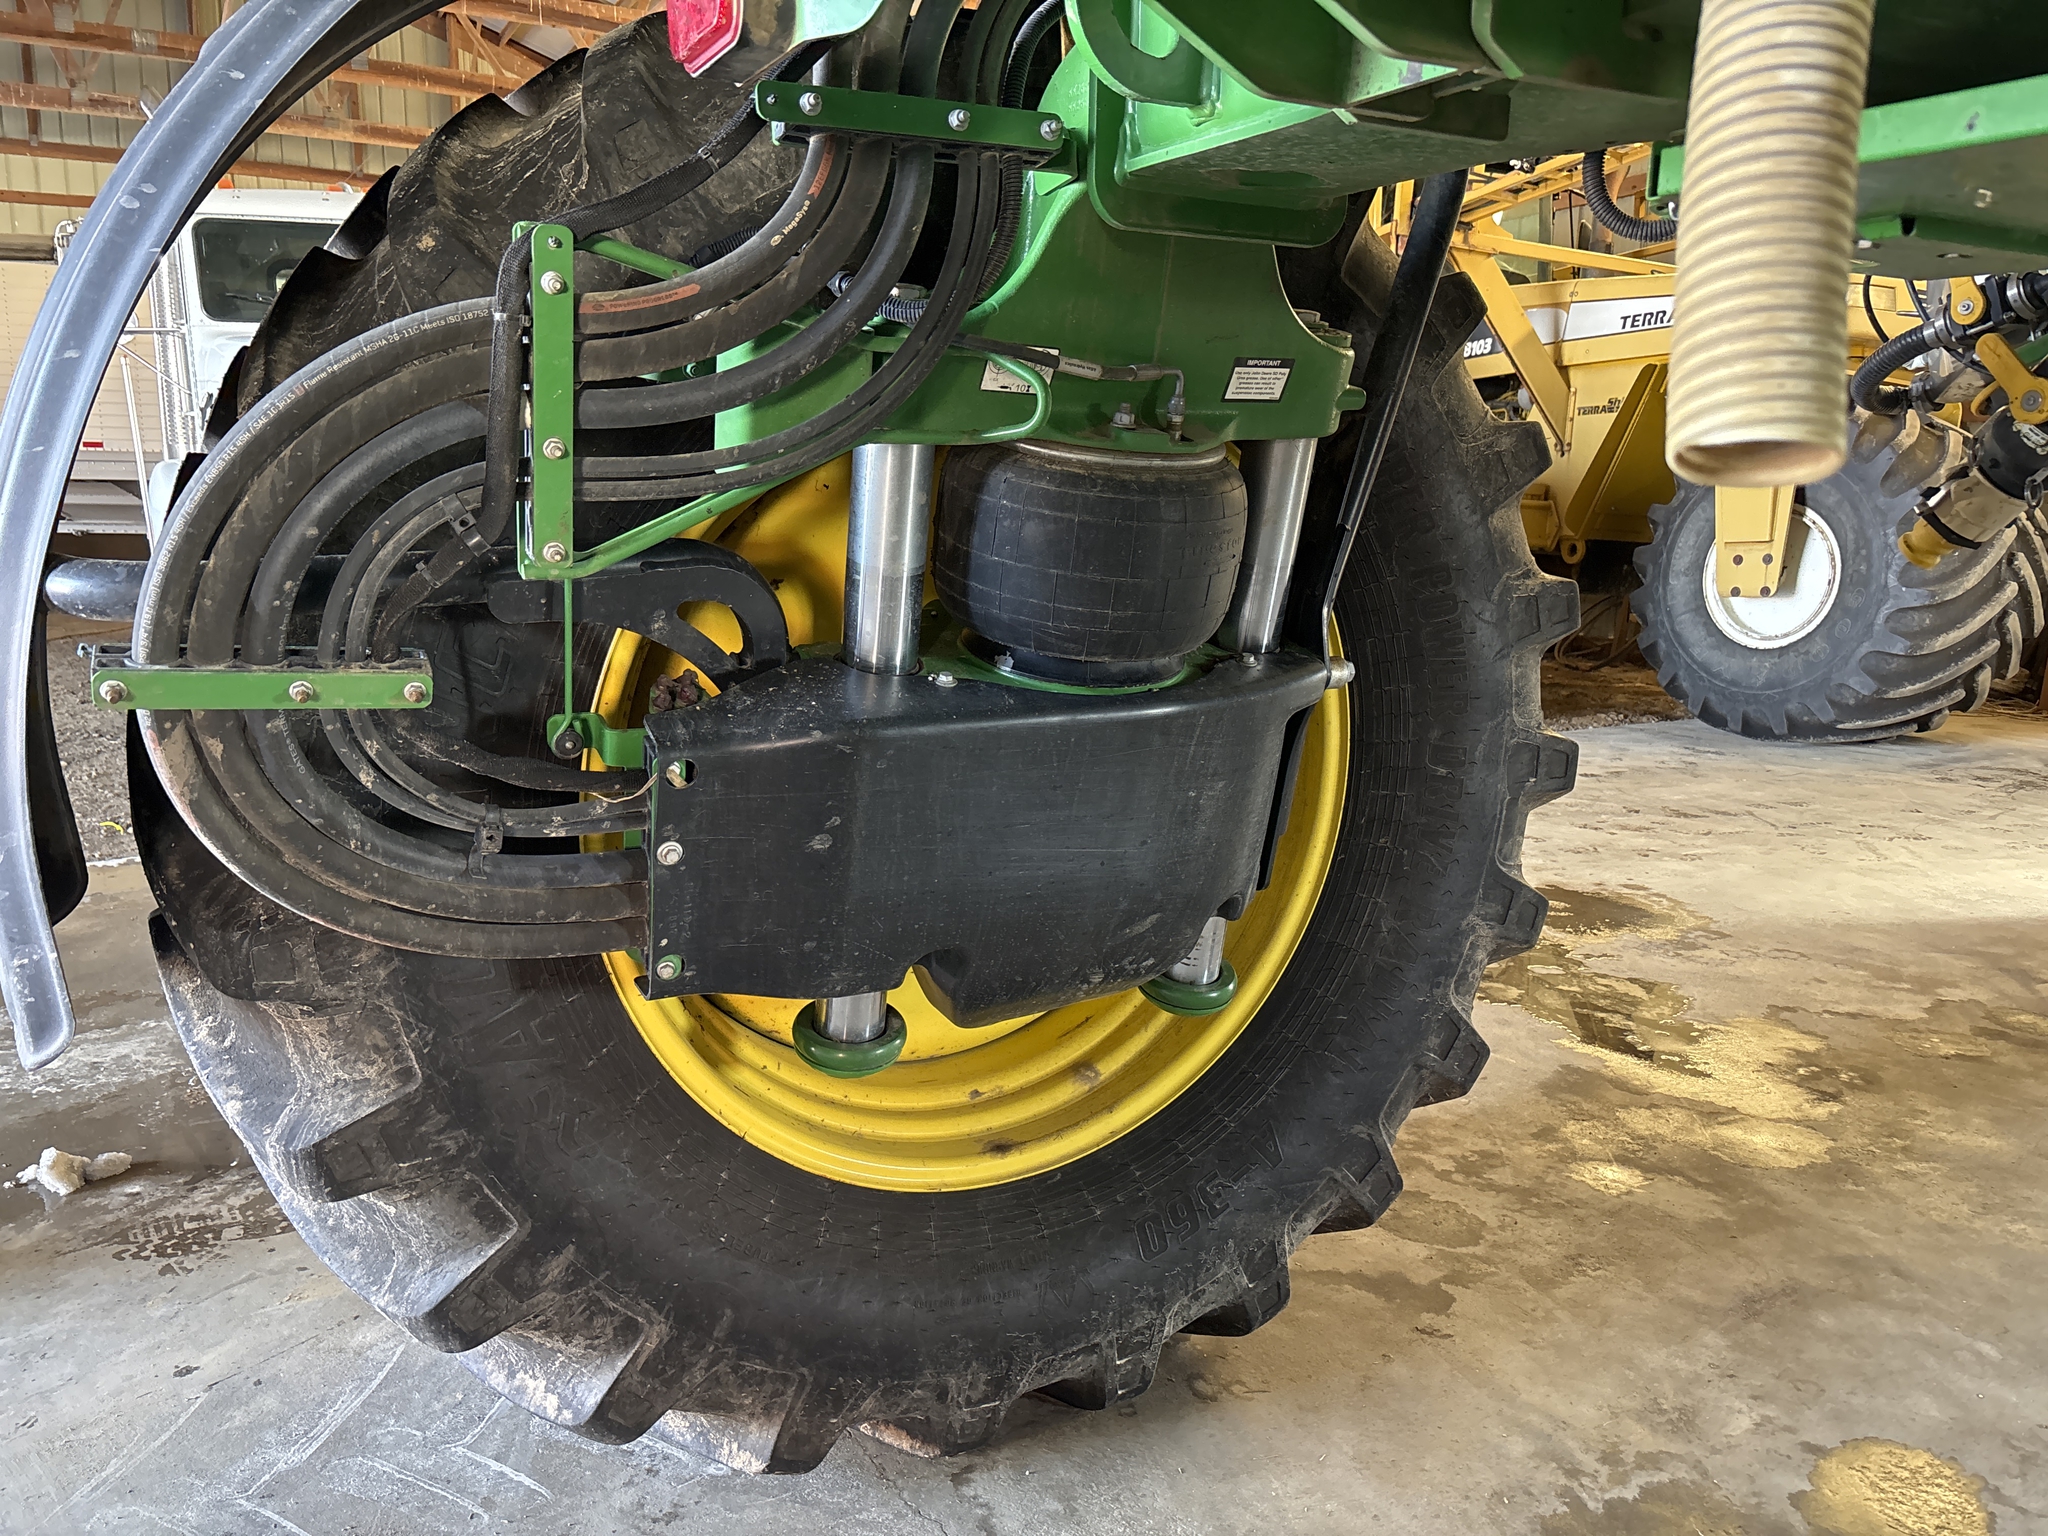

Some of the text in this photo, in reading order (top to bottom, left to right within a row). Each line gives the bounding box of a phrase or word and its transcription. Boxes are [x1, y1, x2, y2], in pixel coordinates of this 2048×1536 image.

[166, 533, 178, 550] R15
[173, 516, 186, 534] 4SH
[185, 482, 208, 512] Exceeds
[222, 445, 237, 461] R15
[235, 430, 251, 447] 4SH
[252, 414, 269, 430] SAE
[302, 369, 328, 389] Flame
[326, 349, 363, 374] Resistant
[362, 337, 388, 354] MSHA
[387, 325, 419, 343] 2G-11C
[420, 318, 445, 331] Meets
[445, 314, 460, 323] ISO
[462, 308, 489, 320] 18752
